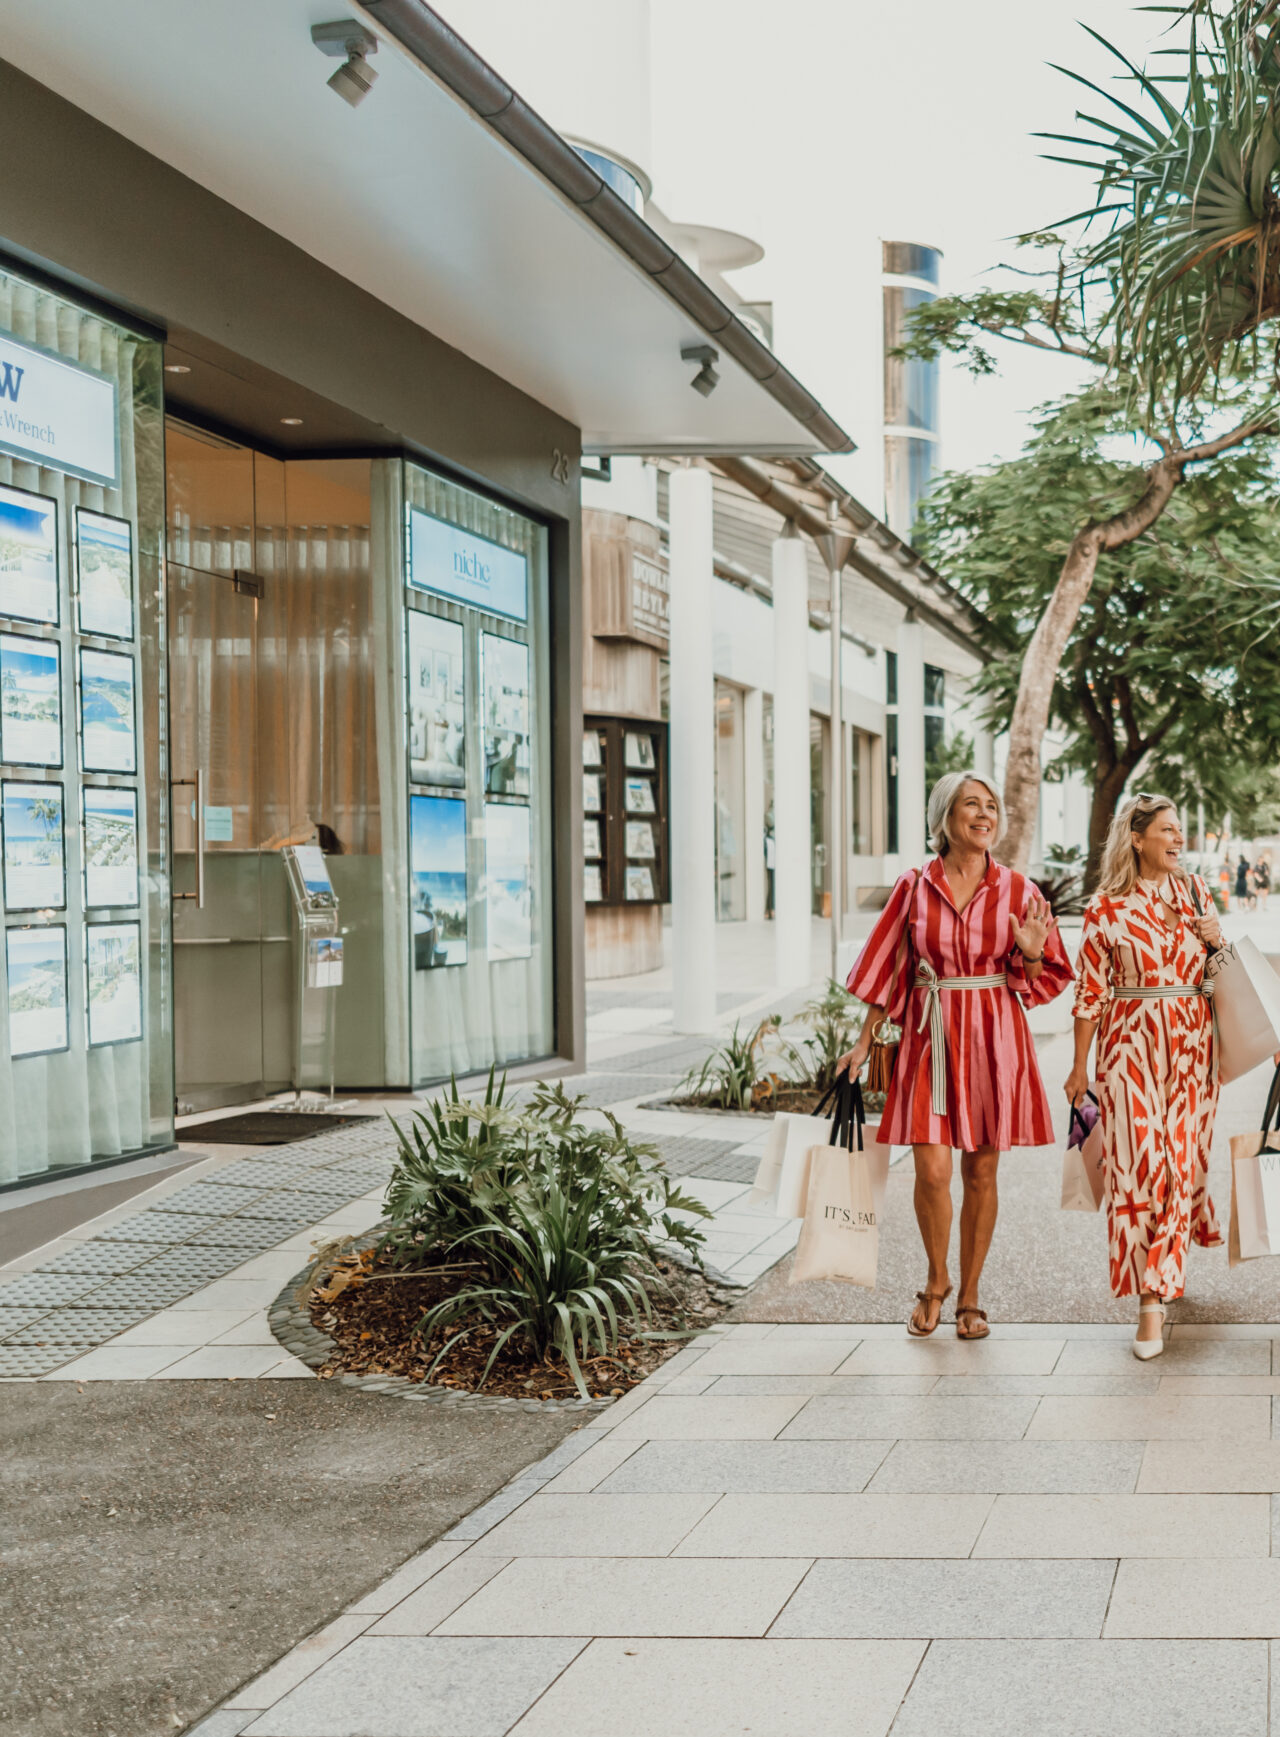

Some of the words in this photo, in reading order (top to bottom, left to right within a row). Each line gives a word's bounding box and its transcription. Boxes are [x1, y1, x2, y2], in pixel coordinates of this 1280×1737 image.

[3, 409, 56, 445] Wrench
[551, 448, 570, 486] 23
[454, 549, 491, 584] niche
[1206, 944, 1236, 977] ERY
